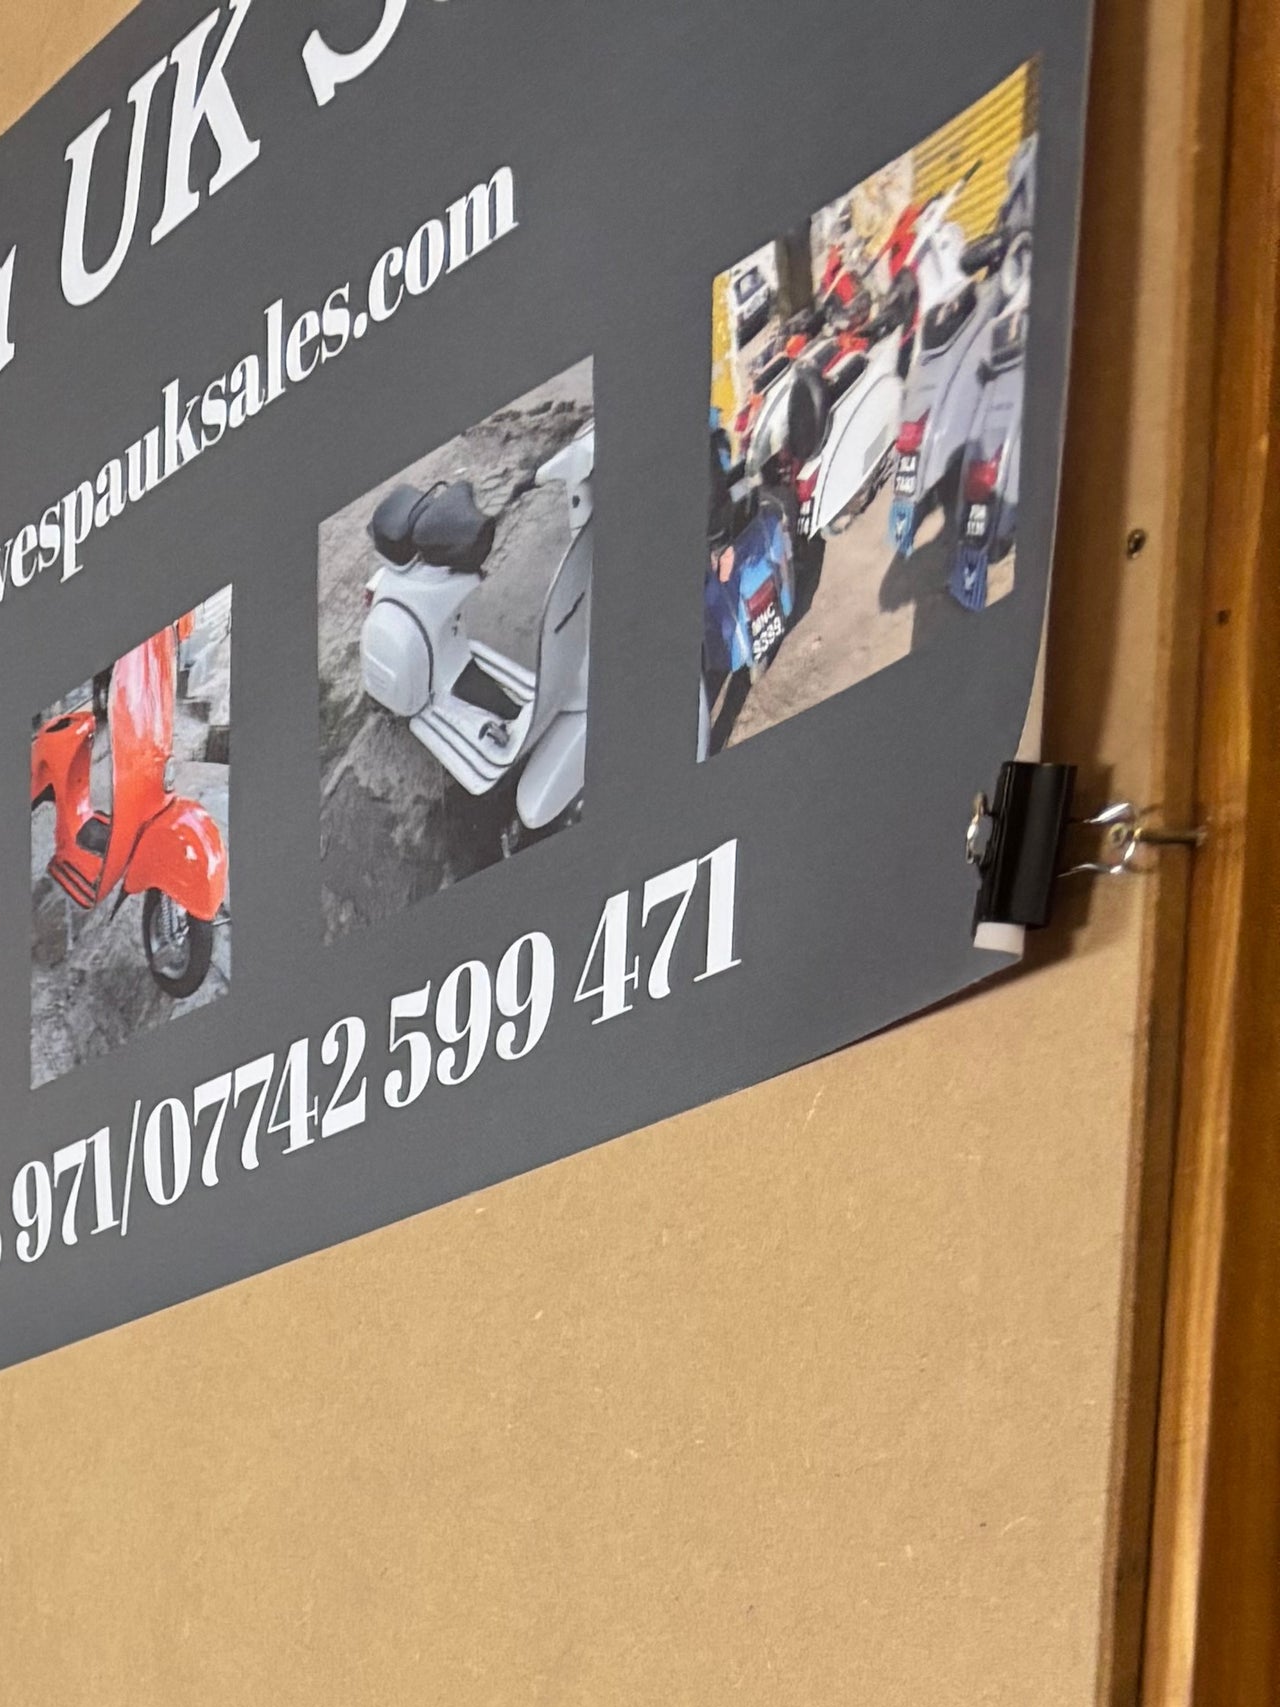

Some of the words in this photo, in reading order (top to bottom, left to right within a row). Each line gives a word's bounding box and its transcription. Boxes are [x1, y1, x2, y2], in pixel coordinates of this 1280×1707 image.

[61, 0, 262, 306] UK
[10, 1014, 367, 1264] 971/07742
[383, 930, 555, 1109] 599
[573, 838, 742, 1026] 471
